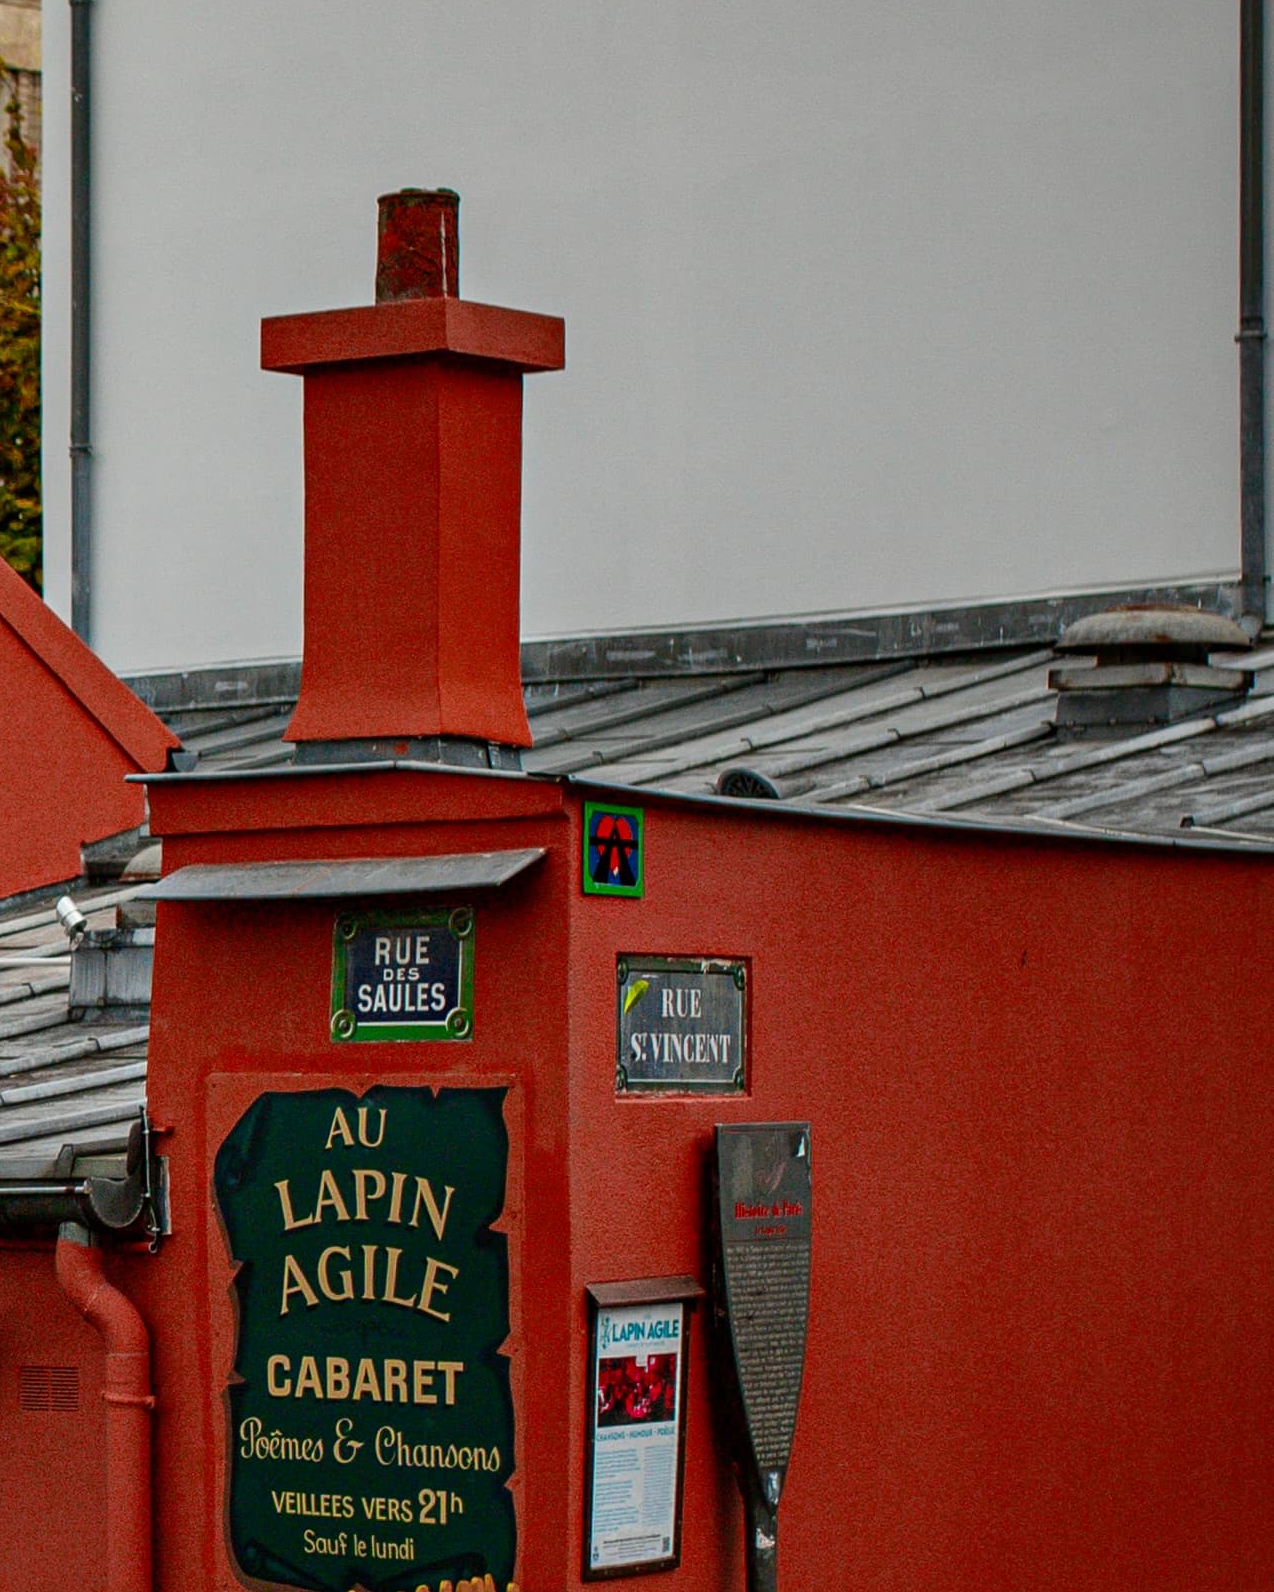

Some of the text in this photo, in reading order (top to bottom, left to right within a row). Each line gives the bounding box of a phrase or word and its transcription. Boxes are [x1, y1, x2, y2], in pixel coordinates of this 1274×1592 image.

[374, 936, 430, 966] RUE
[383, 967, 420, 981] DES
[357, 983, 446, 1013] SAULES
[661, 988, 702, 1018] RUE
[650, 1033, 731, 1064] VINCENT
[325, 1106, 388, 1151] AU
[274, 1168, 455, 1241] LAPIN
[279, 1244, 459, 1323] AGILE
[612, 1318, 679, 1342] LAPIN AGILE
[266, 1354, 464, 1405] CABARET
[333, 1417, 365, 1464] &
[374, 1425, 502, 1472] Chansons
[271, 1488, 464, 1525] VEILLEES VERS 21h
[303, 1529, 415, 1560] Sauf le lundi
